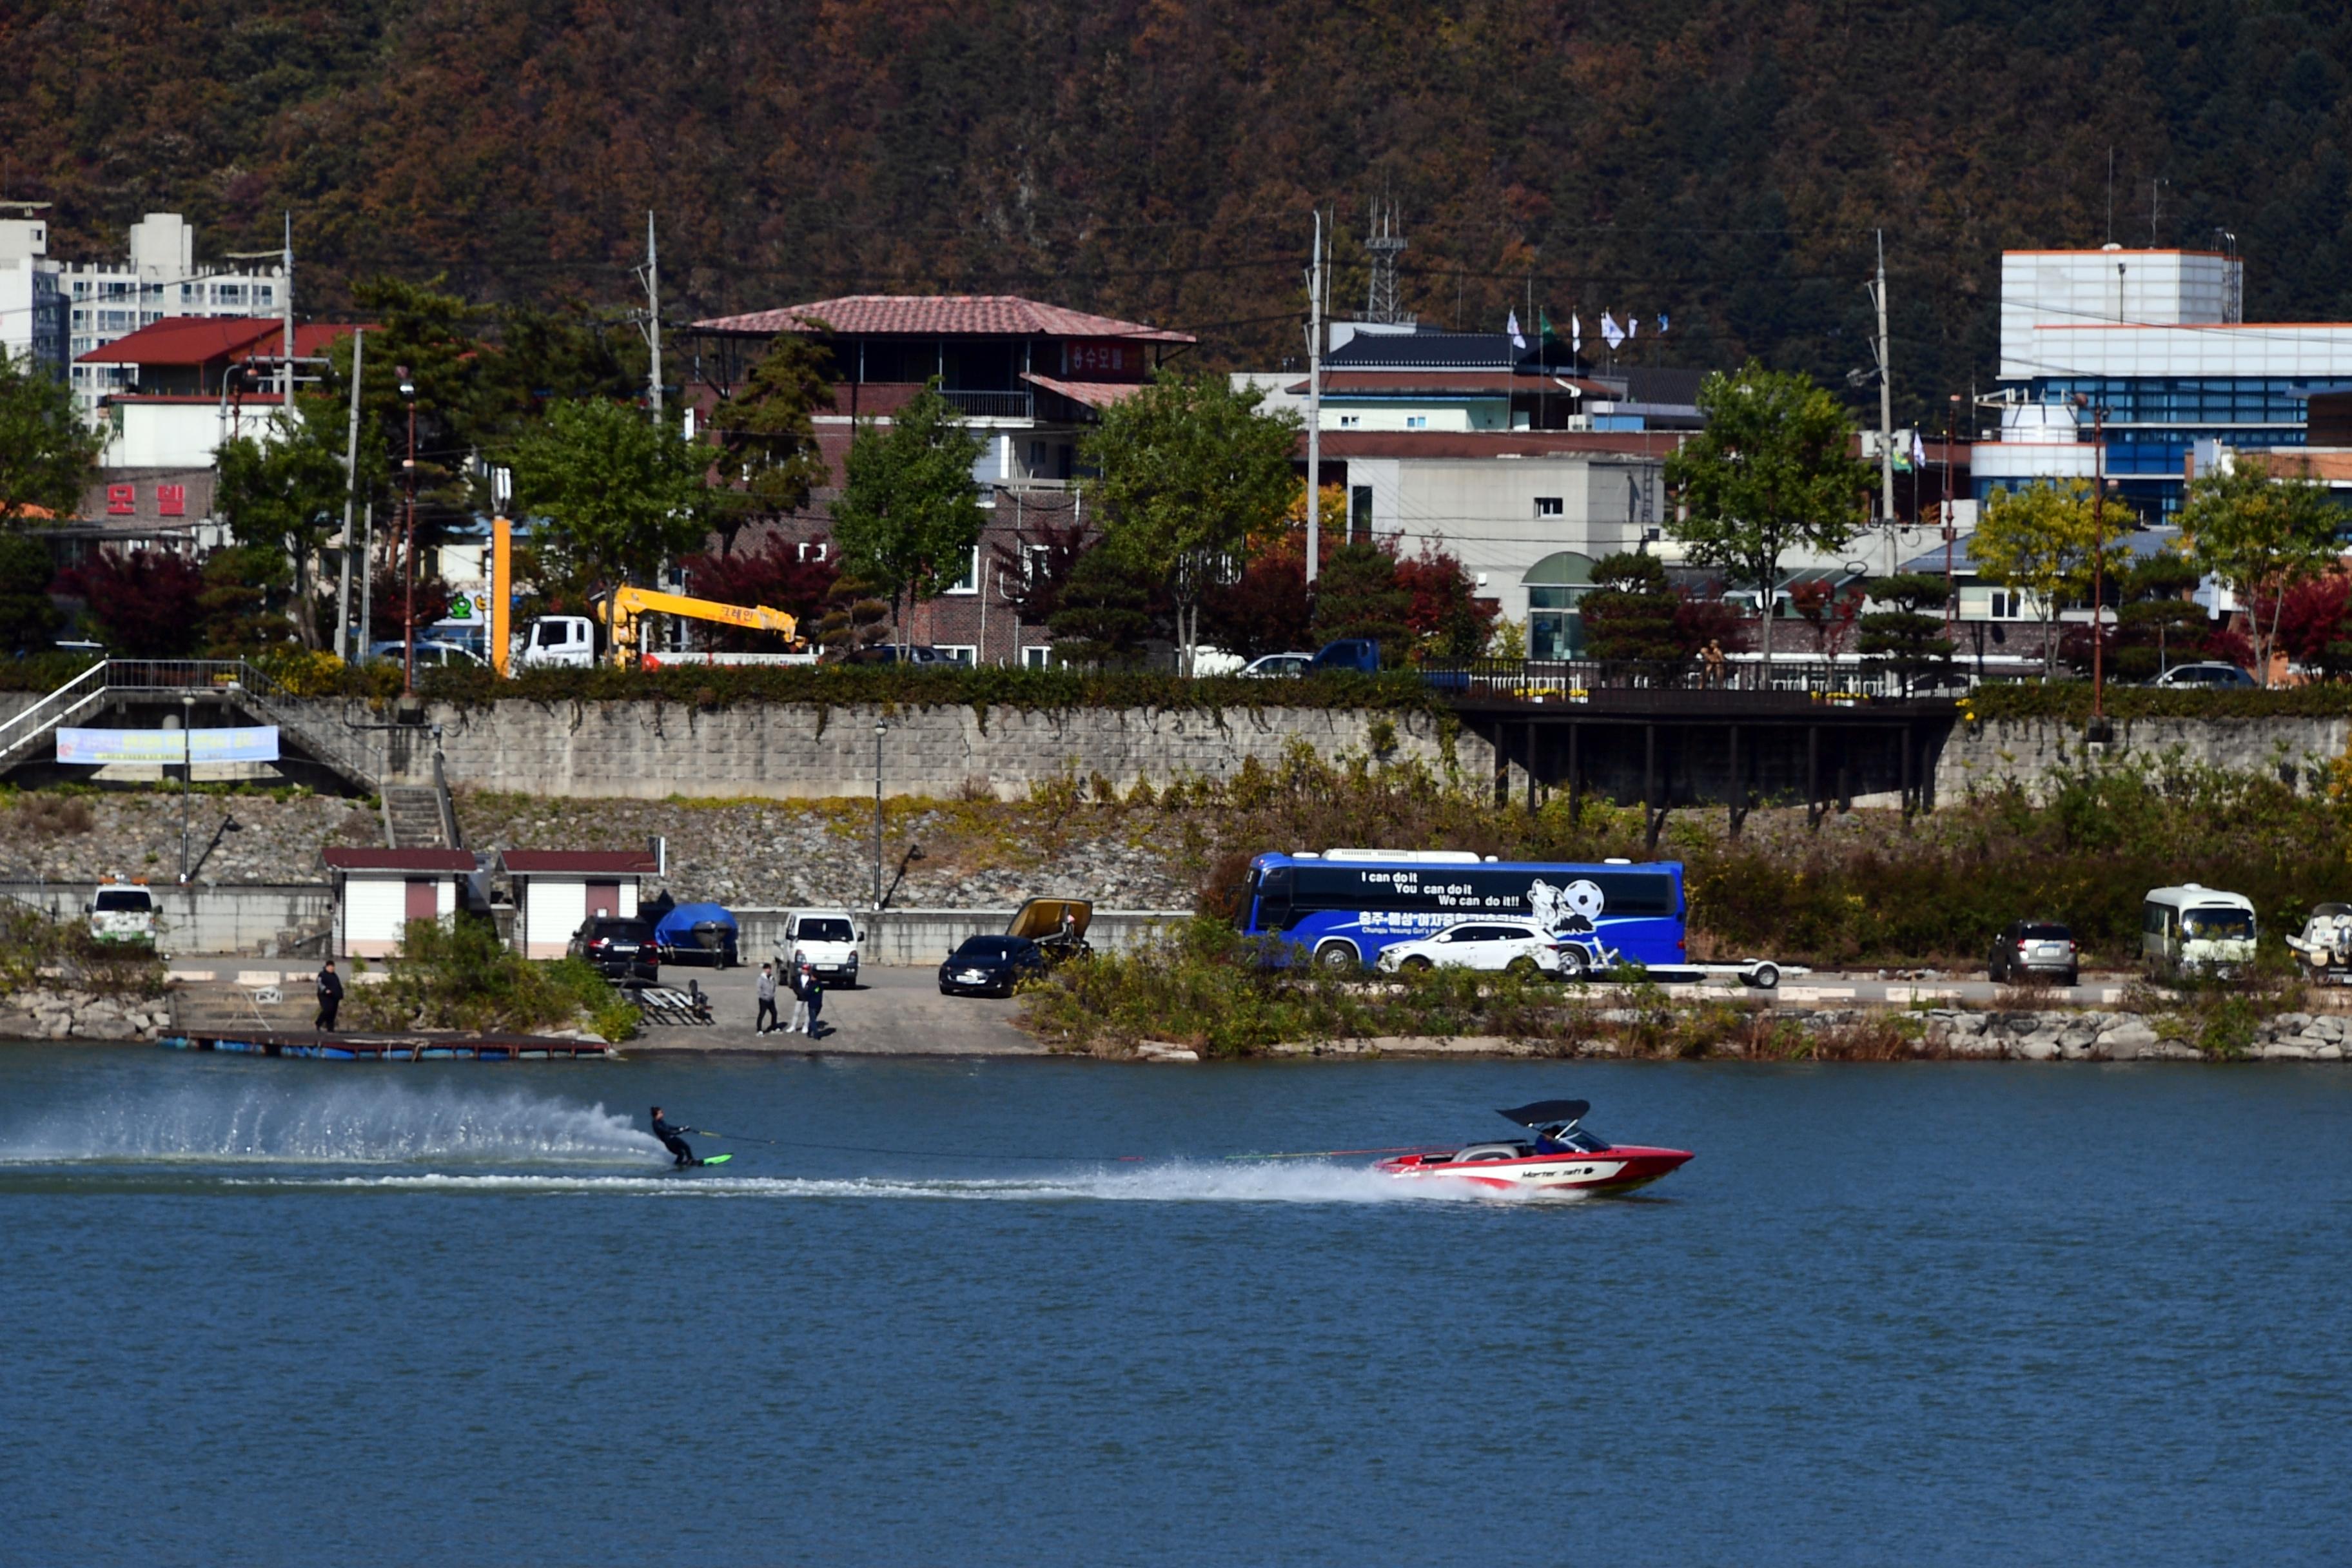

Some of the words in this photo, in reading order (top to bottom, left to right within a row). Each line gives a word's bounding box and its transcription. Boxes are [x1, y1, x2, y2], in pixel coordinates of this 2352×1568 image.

[1361, 871, 1366, 882] I
[1368, 874, 1391, 883] can
[1394, 883, 1418, 894] You
[1423, 885, 1445, 894] can
[1438, 894, 1456, 906] We
[1458, 897, 1480, 906] can
[1485, 896, 1500, 906] do
[1502, 896, 1520, 907] it!!
